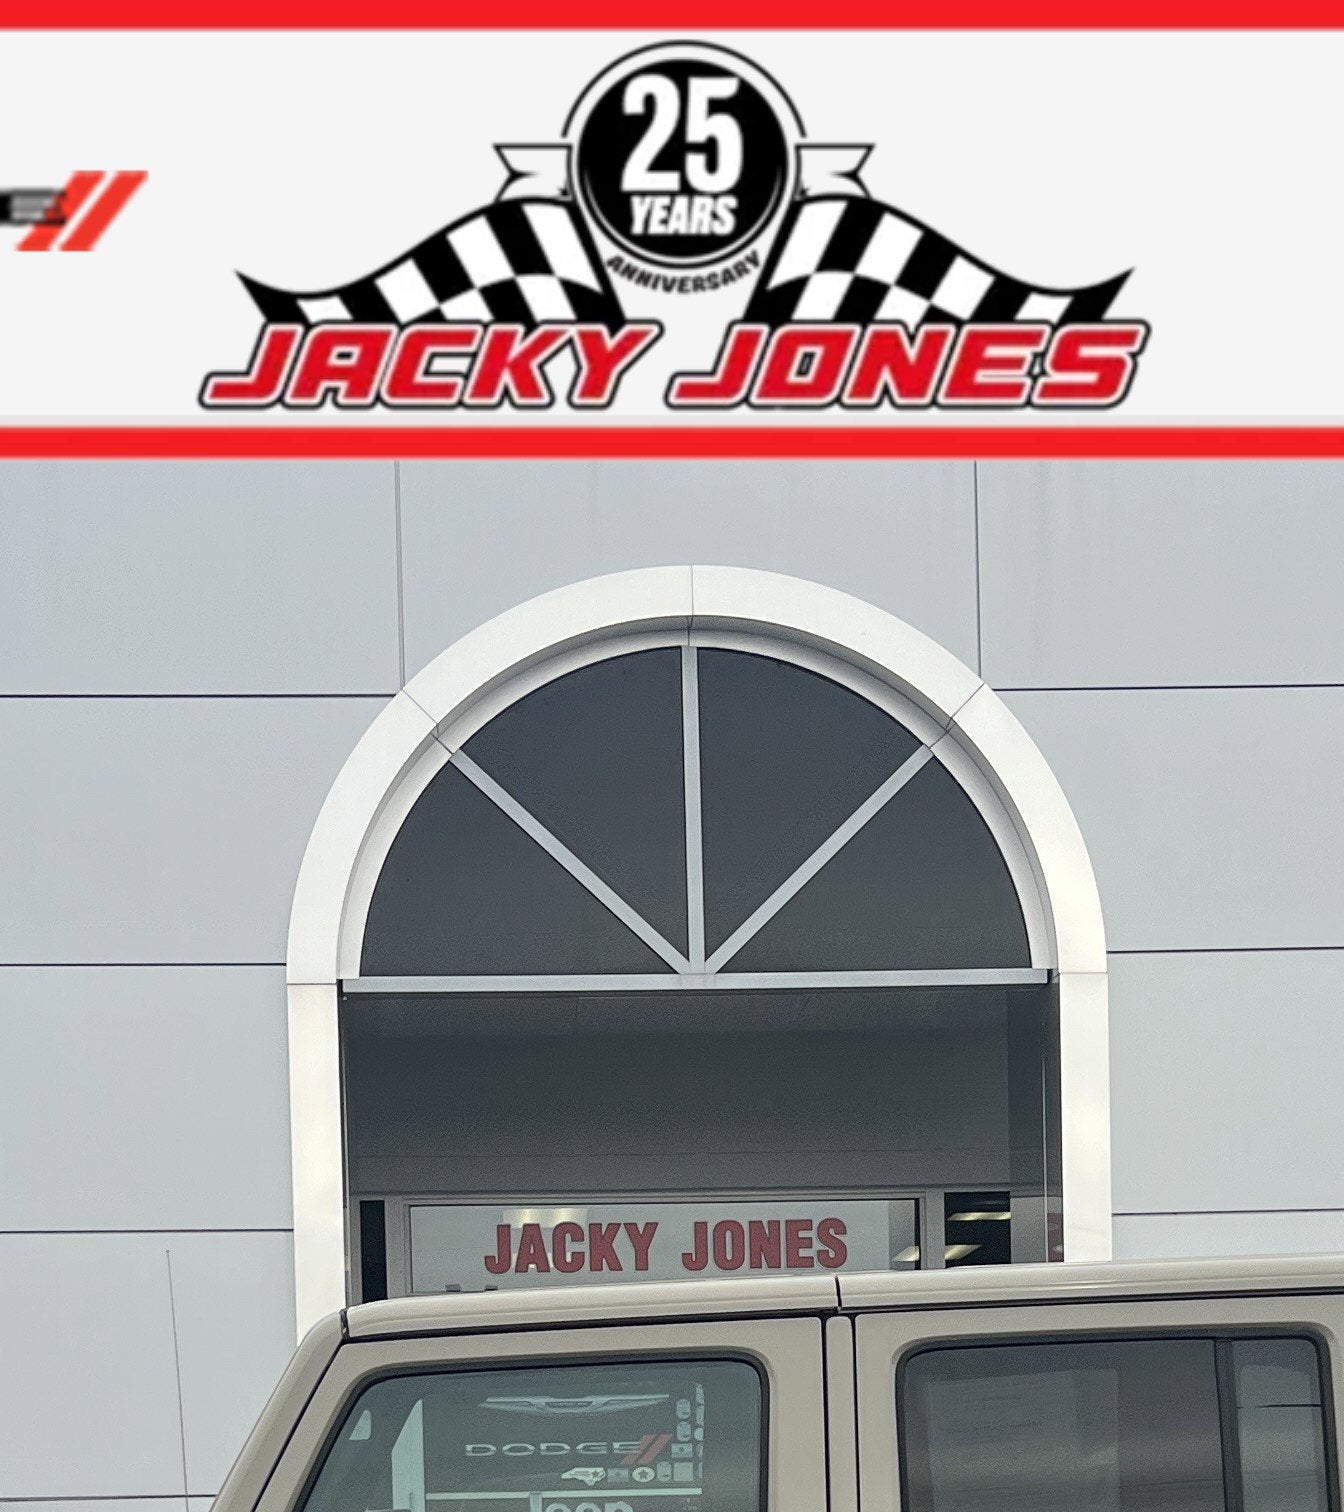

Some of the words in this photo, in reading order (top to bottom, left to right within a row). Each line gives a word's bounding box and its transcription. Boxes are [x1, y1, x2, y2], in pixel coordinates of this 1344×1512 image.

[483, 1221, 659, 1275] JACKY
[681, 1217, 848, 1271] JONES
[465, 1440, 644, 1457] DODGE
